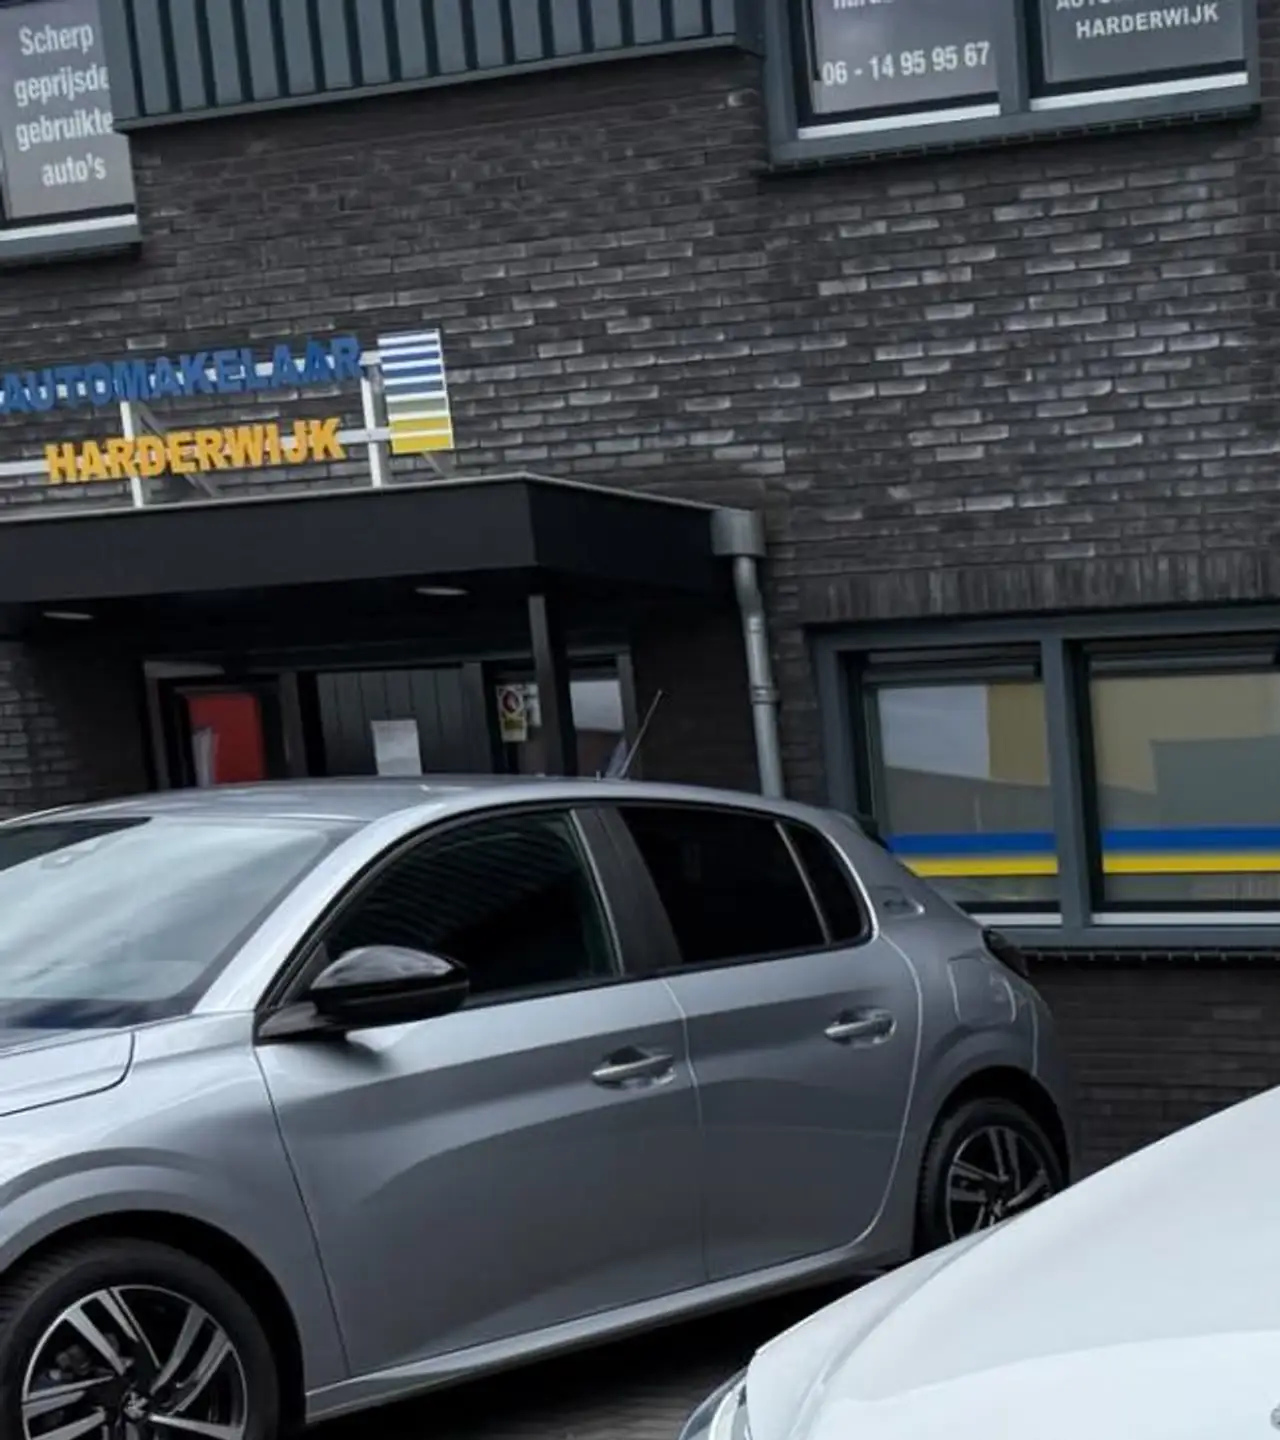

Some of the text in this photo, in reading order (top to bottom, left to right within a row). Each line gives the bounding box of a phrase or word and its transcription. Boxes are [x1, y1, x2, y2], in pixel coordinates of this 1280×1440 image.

[19, 24, 95, 56] Scherp
[1075, 2, 1220, 40] HARDERWIJK
[821, 61, 848, 87] 06
[869, 53, 895, 81] 14
[900, 49, 927, 76] 95
[931, 45, 959, 72] 95
[964, 40, 991, 67] 67
[15, 107, 114, 152] gebruikte
[42, 152, 107, 187] auto's
[0, 334, 364, 415] AUTOMAKELAAR
[45, 417, 347, 484] HARDERWIJK
